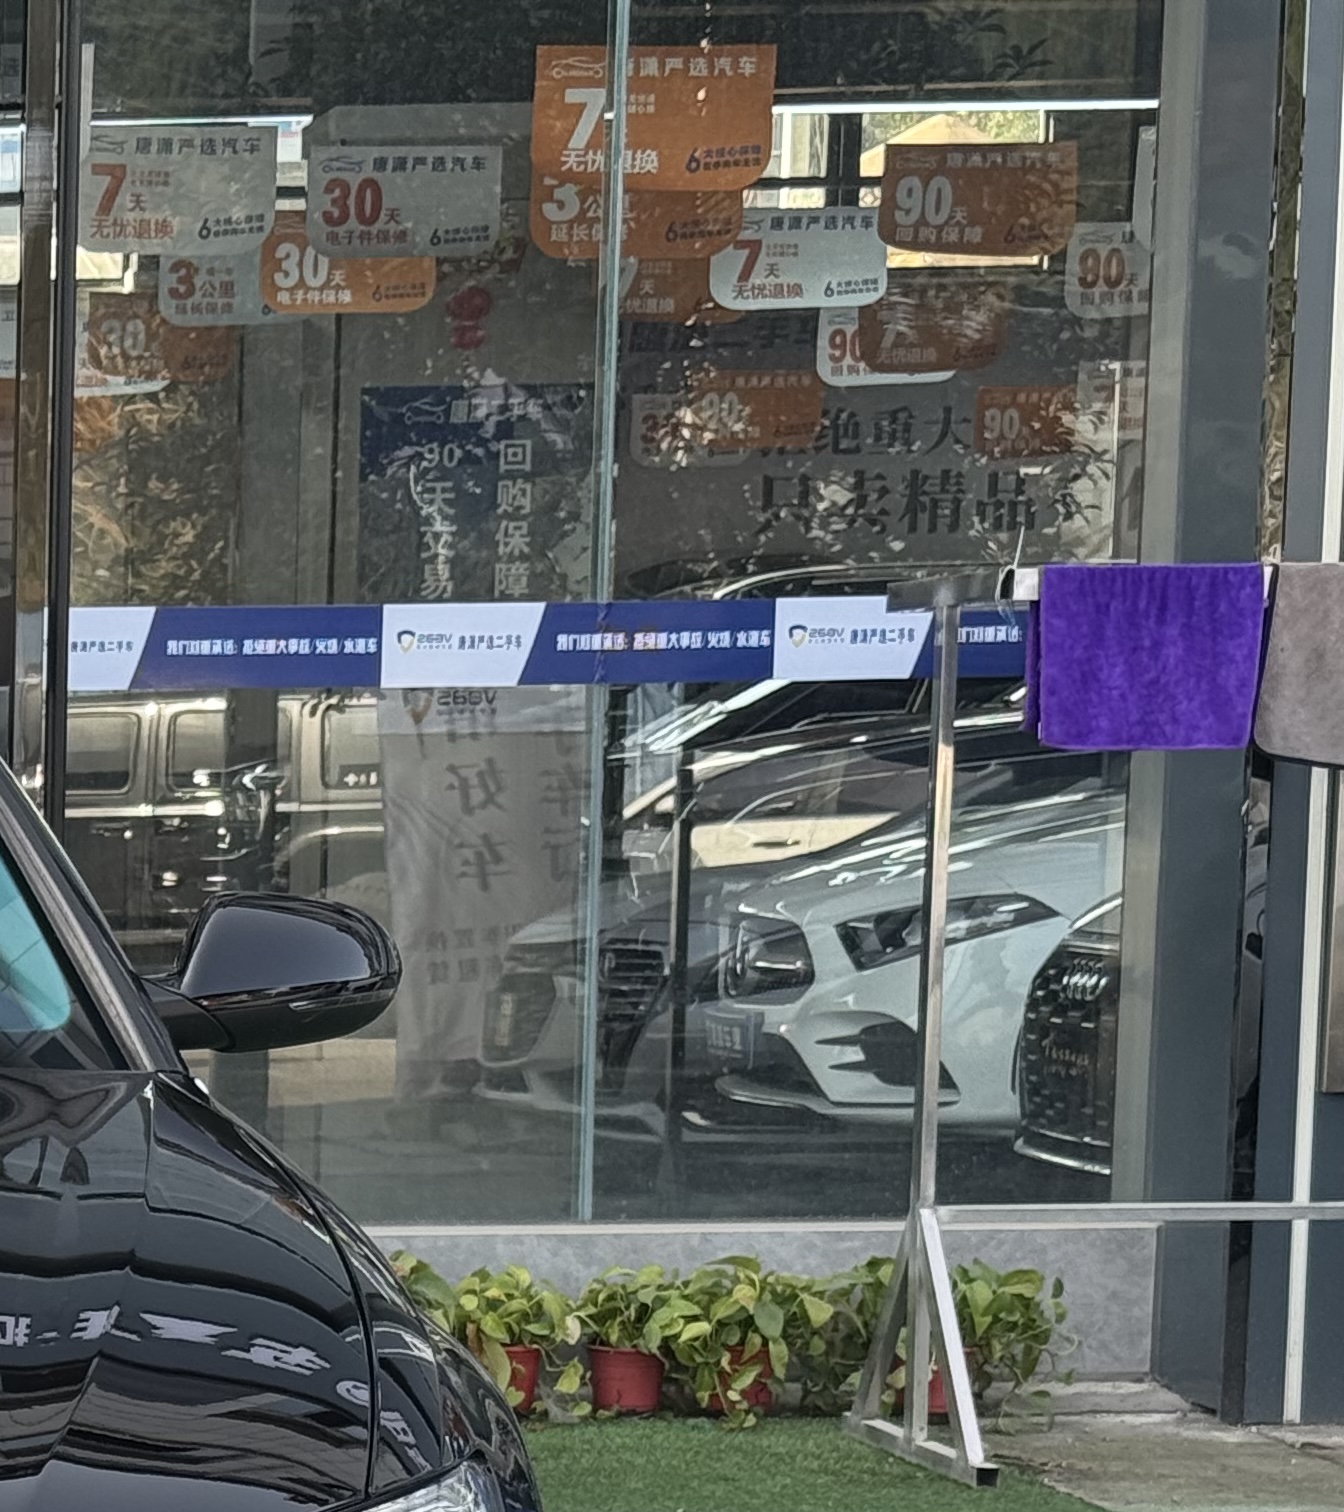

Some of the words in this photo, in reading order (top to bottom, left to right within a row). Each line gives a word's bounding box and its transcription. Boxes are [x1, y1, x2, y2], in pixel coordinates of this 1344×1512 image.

[134, 136, 262, 156] 唐潇严选汽车
[371, 155, 488, 173] 唐潇严选汽车
[322, 176, 401, 228] 30天
[894, 175, 968, 226] 90天
[89, 218, 175, 240] 无忧退换
[325, 229, 409, 247] 电子件保修
[895, 226, 983, 243] 回购保障
[273, 242, 347, 289] 30天
[276, 289, 353, 305] 电子件保修
[732, 283, 804, 300] 无忧退换
[761, 405, 972, 455] 绝重大
[493, 439, 532, 598] 回购保障
